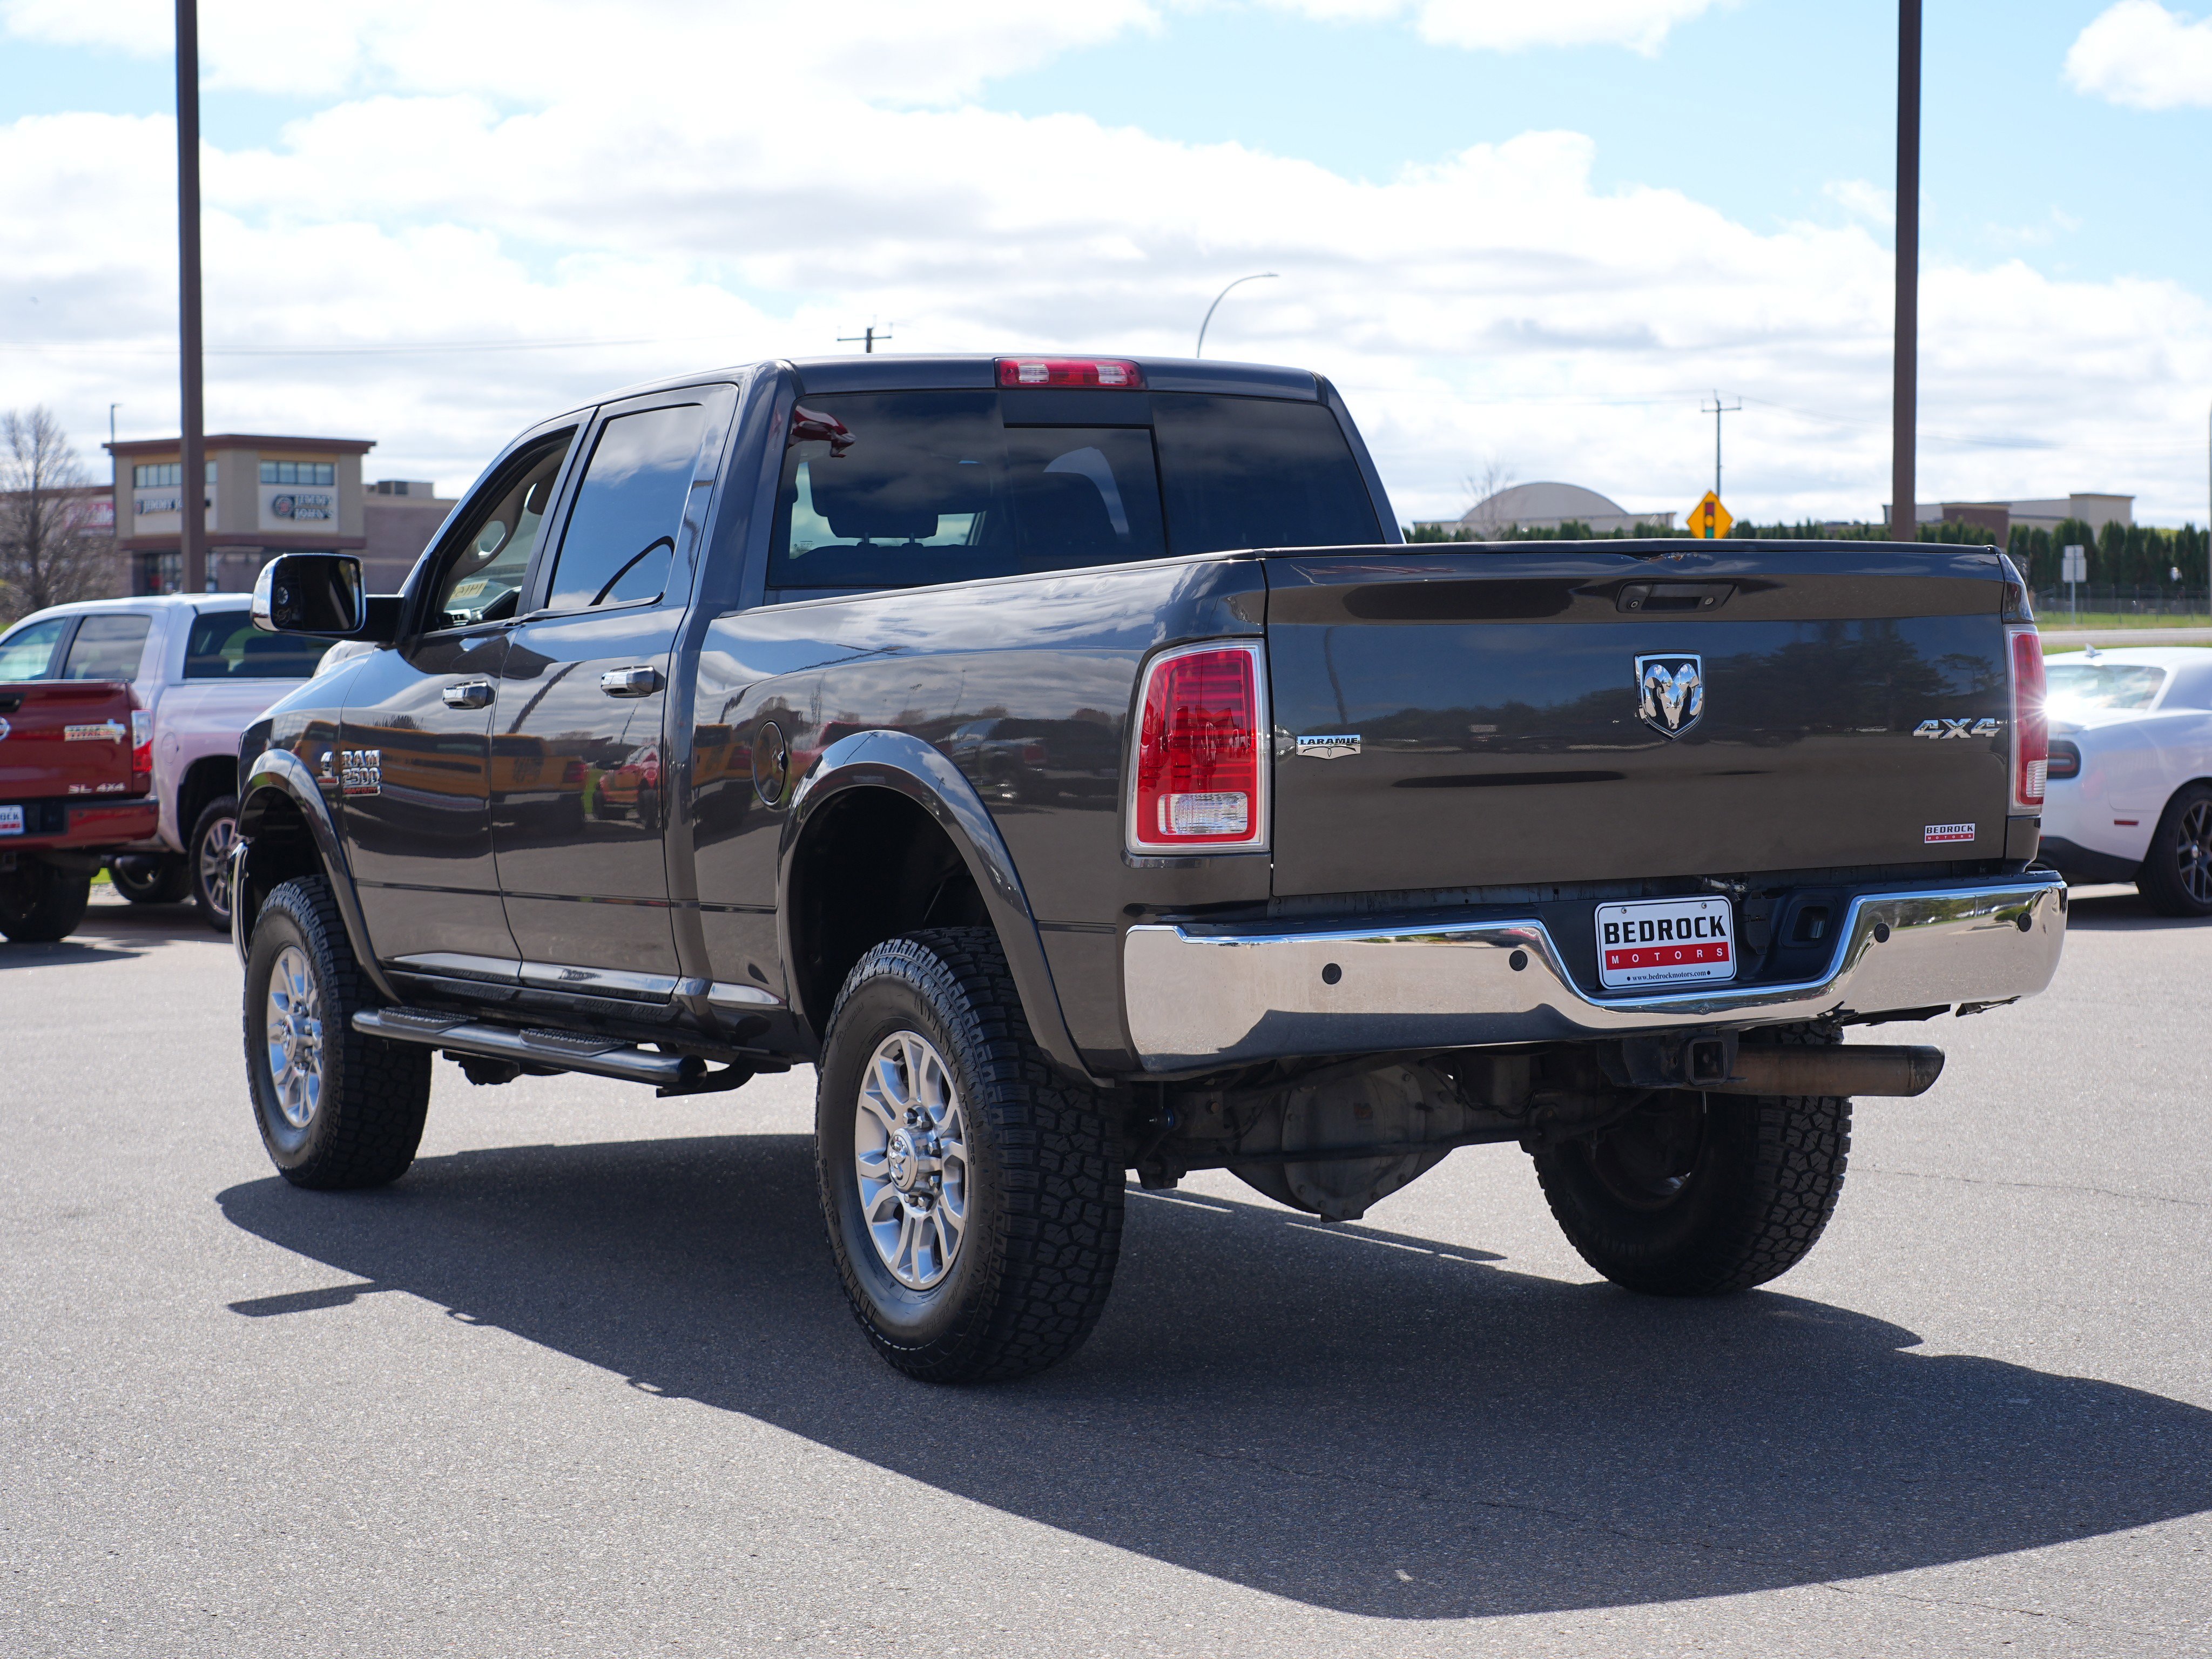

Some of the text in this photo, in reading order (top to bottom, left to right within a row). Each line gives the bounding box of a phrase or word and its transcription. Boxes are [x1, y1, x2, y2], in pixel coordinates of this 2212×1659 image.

[294, 495, 334, 506] JIMMY
[294, 508, 334, 521] JOHN'S
[341, 750, 381, 767] RAM
[342, 767, 382, 785] 2500
[68, 784, 92, 794] SL
[1926, 825, 1973, 834] BEDROCK
[1604, 915, 1727, 945] BEDROCK
[1611, 948, 1723, 965] MOTORS
[1632, 970, 1707, 981] www.bedrockmotors.com
